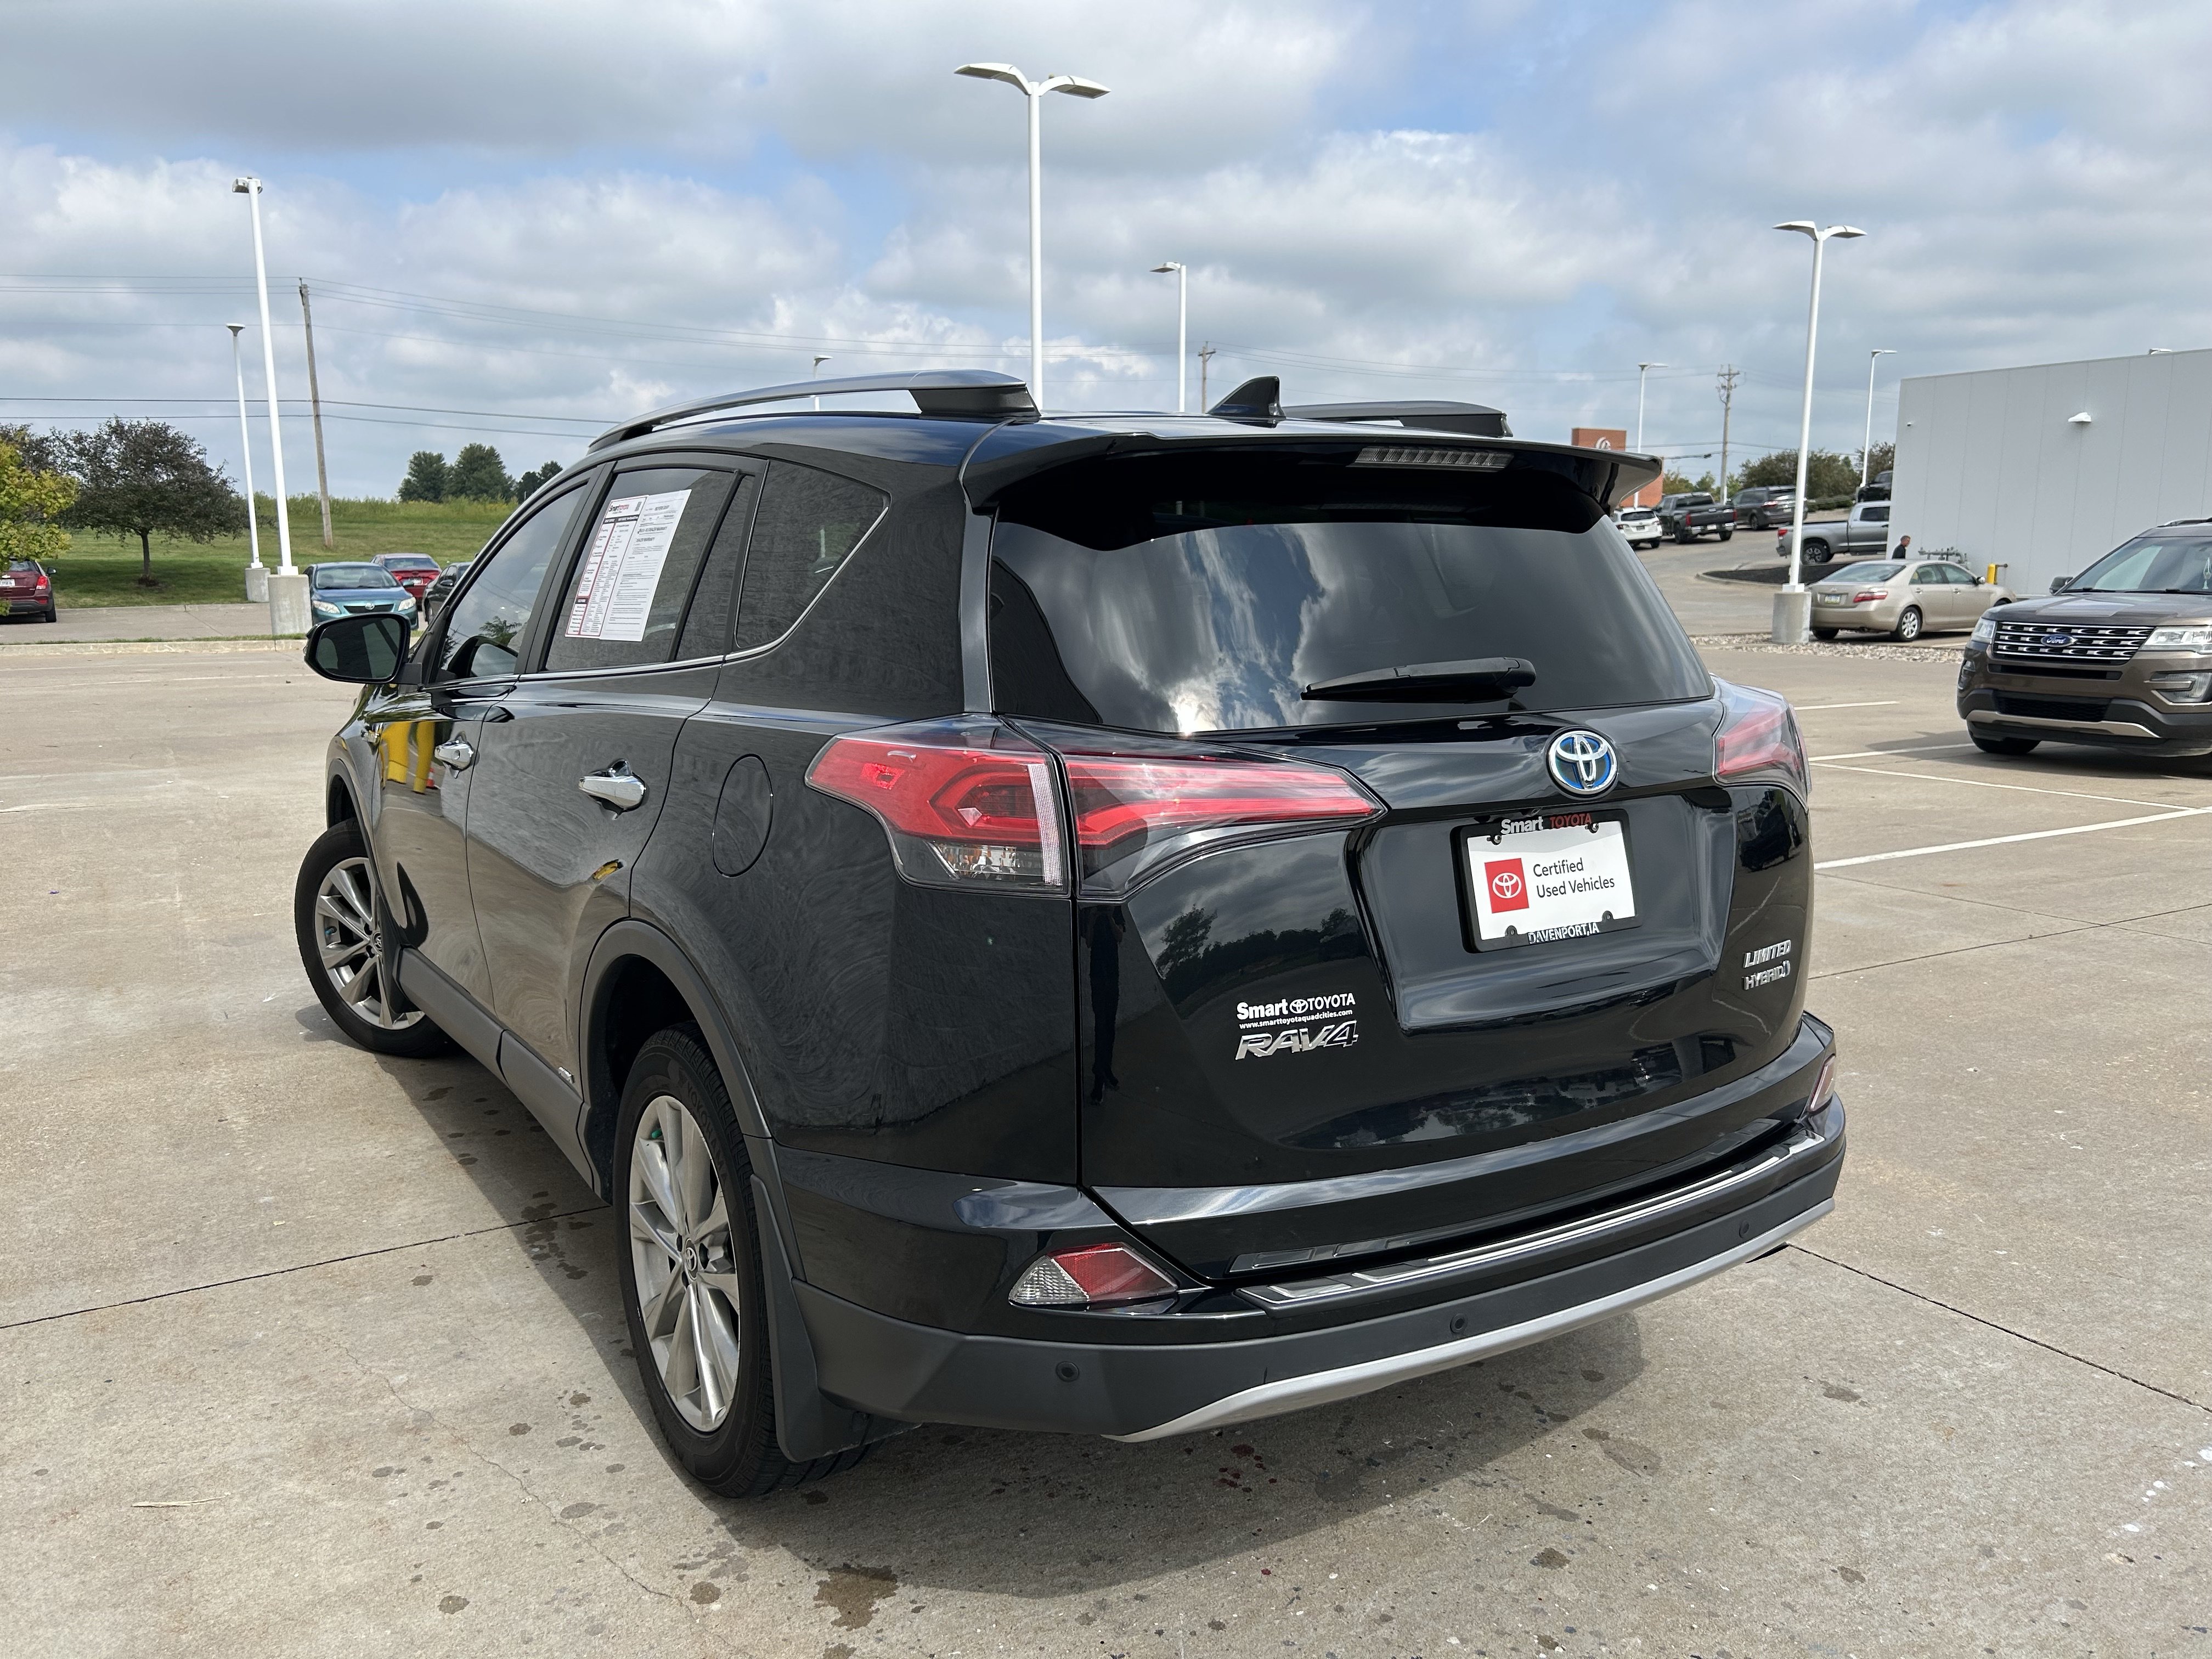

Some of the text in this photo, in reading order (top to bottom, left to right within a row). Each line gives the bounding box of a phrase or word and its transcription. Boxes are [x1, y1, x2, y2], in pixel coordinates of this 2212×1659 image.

[2046, 636, 2067, 644] Ford
[1500, 812, 1592, 834] Smart TOYOTA
[1533, 857, 1584, 877] Certified
[1536, 876, 1615, 898] Used Vehicles
[1743, 939, 1791, 968] LIMITED
[1743, 965, 1786, 990] HYBRID
[1237, 992, 1356, 1020] Smart TOYOTA
[1239, 1009, 1353, 1029] www.smarttoyotaquadcities.com
[1235, 1020, 1359, 1060] RAV4
[687, 1082, 728, 1185] YOKOHAMA
